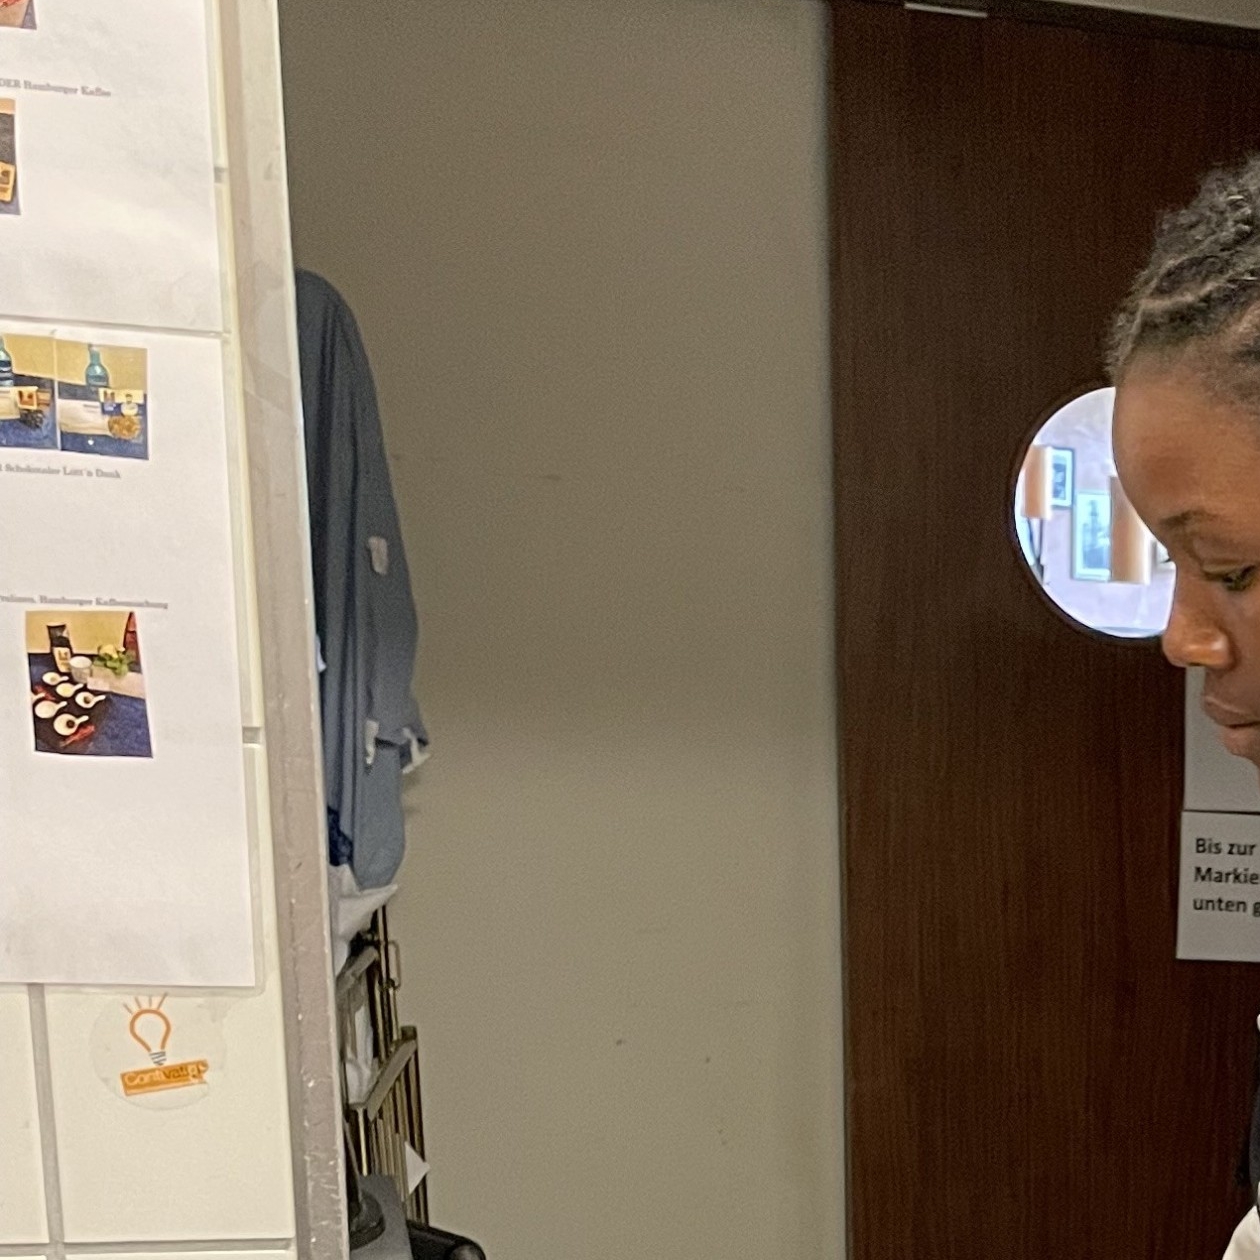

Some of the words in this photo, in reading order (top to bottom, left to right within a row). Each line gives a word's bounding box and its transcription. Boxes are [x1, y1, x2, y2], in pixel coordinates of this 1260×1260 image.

[1195, 838, 1222, 854] Bis
[1227, 843, 1257, 856] zur
[1193, 897, 1247, 912] unten
